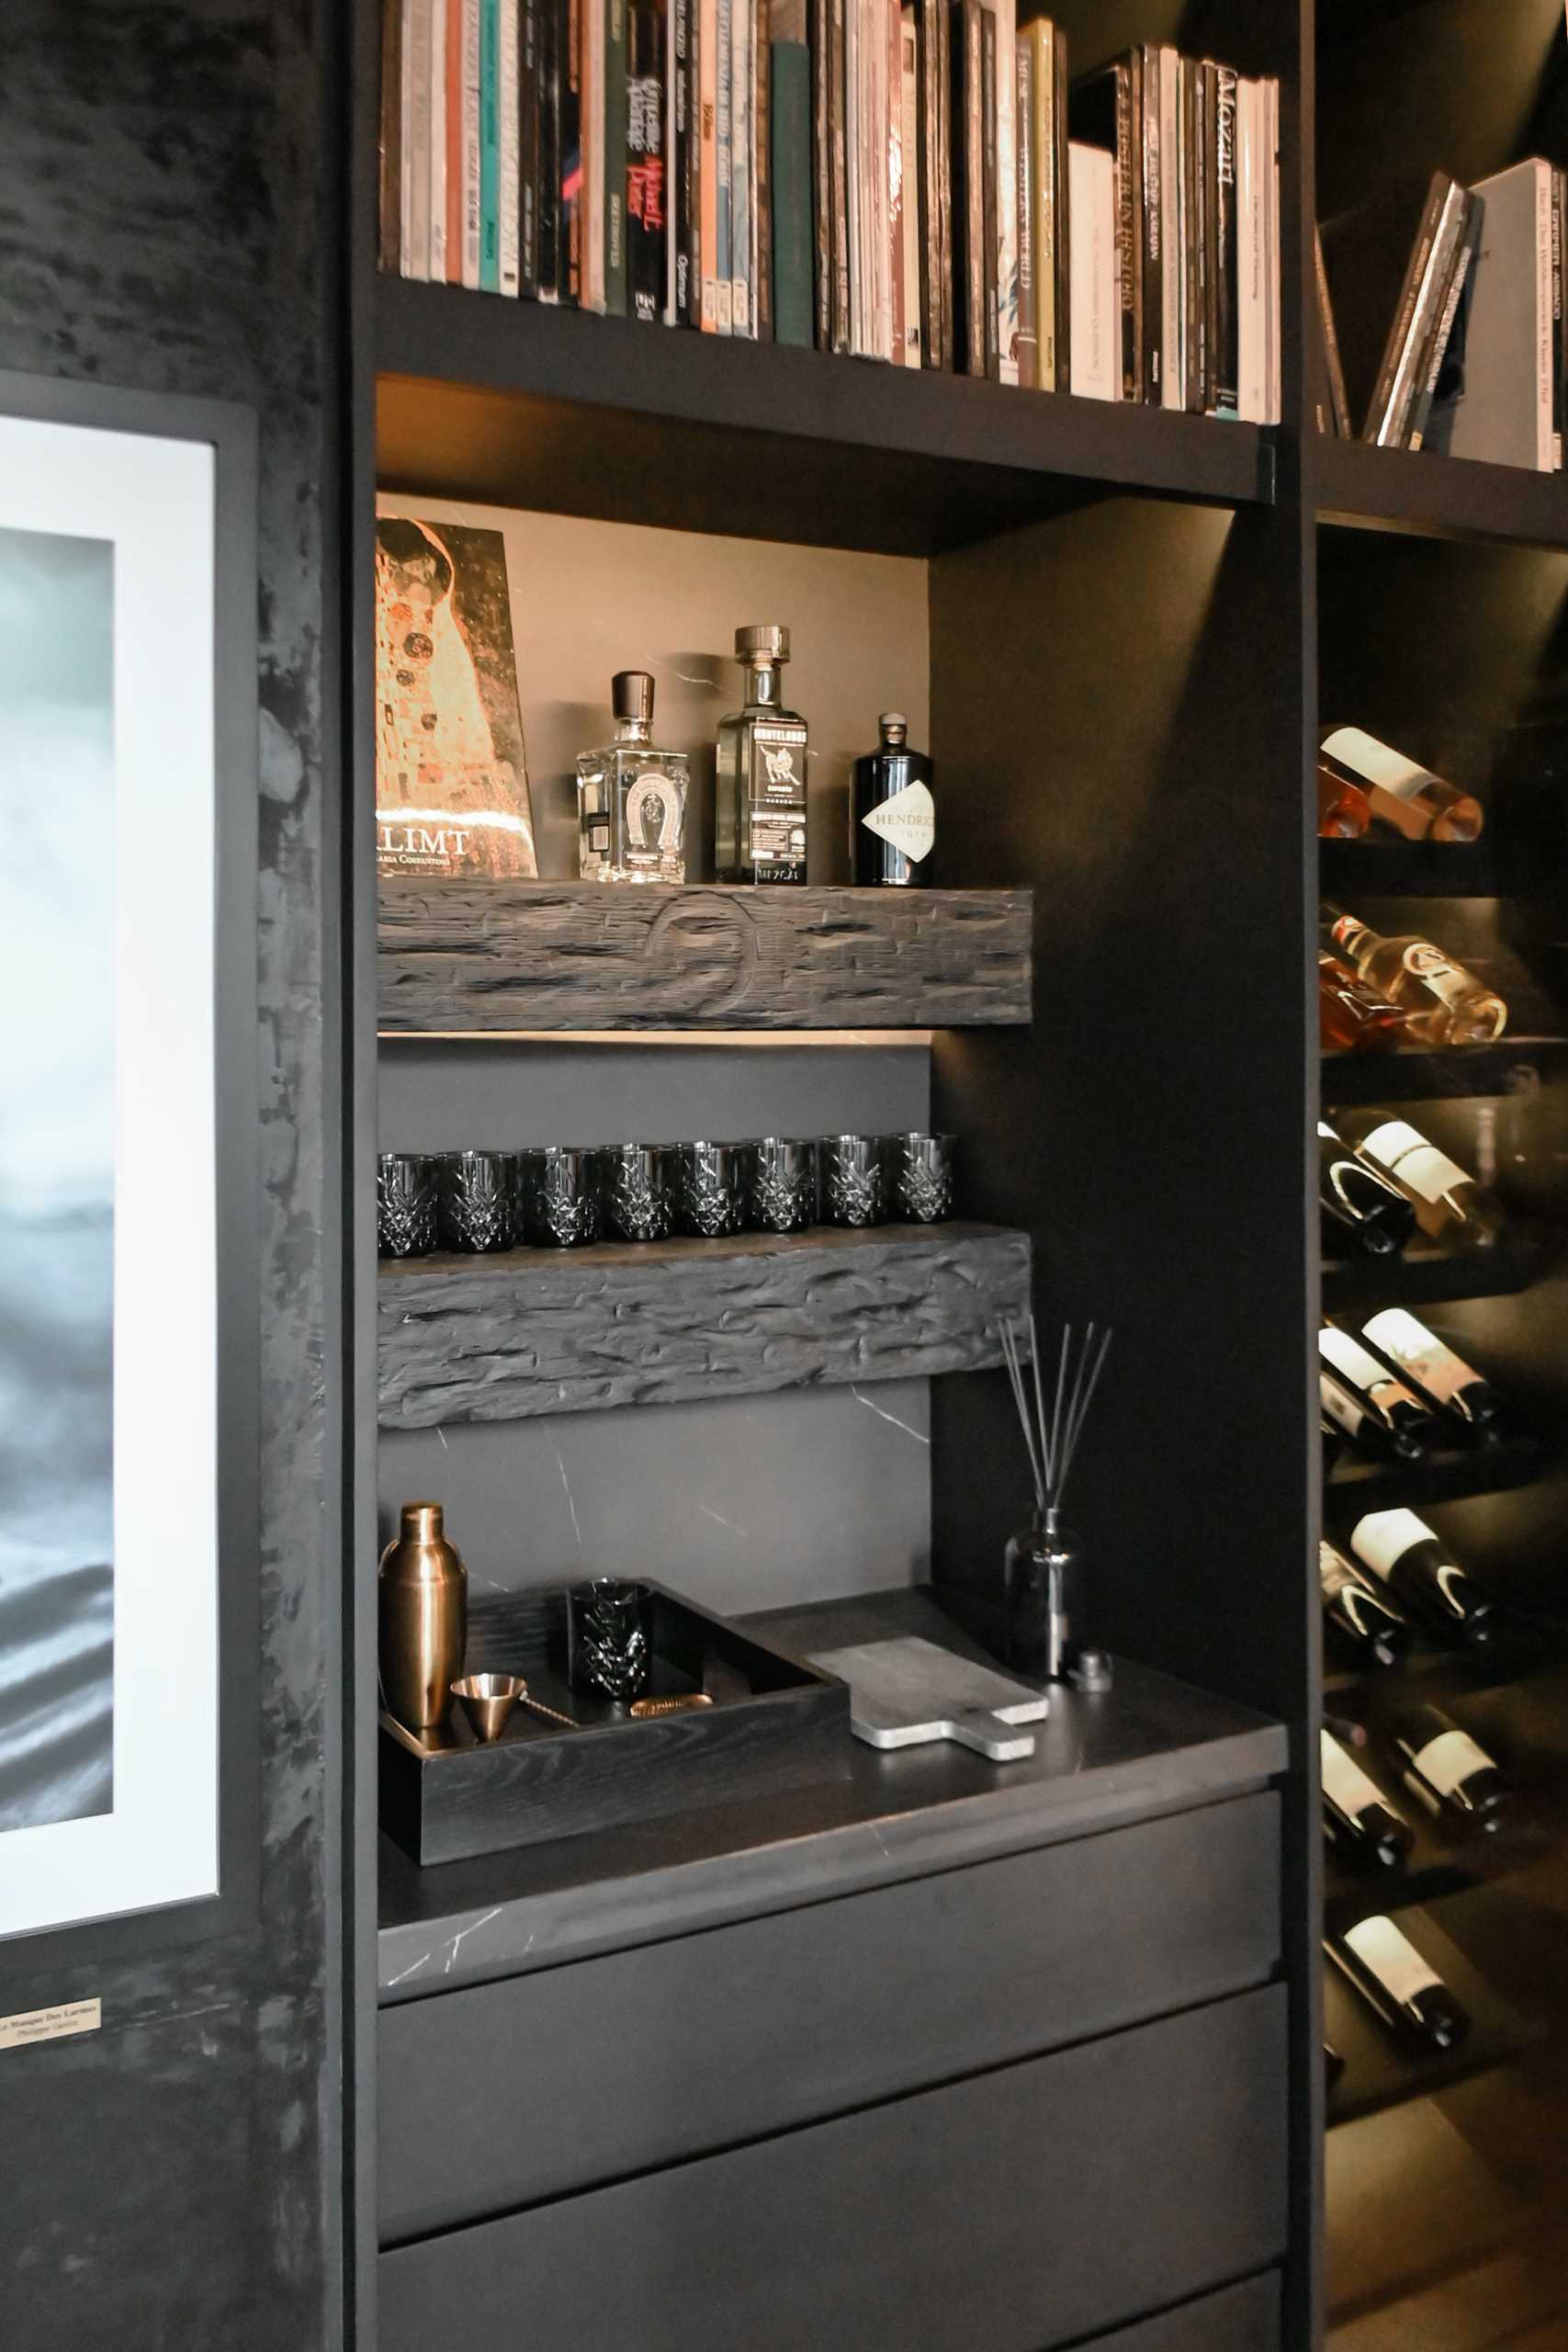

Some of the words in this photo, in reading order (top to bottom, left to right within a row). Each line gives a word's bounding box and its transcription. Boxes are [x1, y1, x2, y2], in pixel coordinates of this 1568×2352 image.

[1215, 73, 1236, 185] Mozart
[376, 826, 470, 855] LIMT
[377, 855, 398, 865] ARIA
